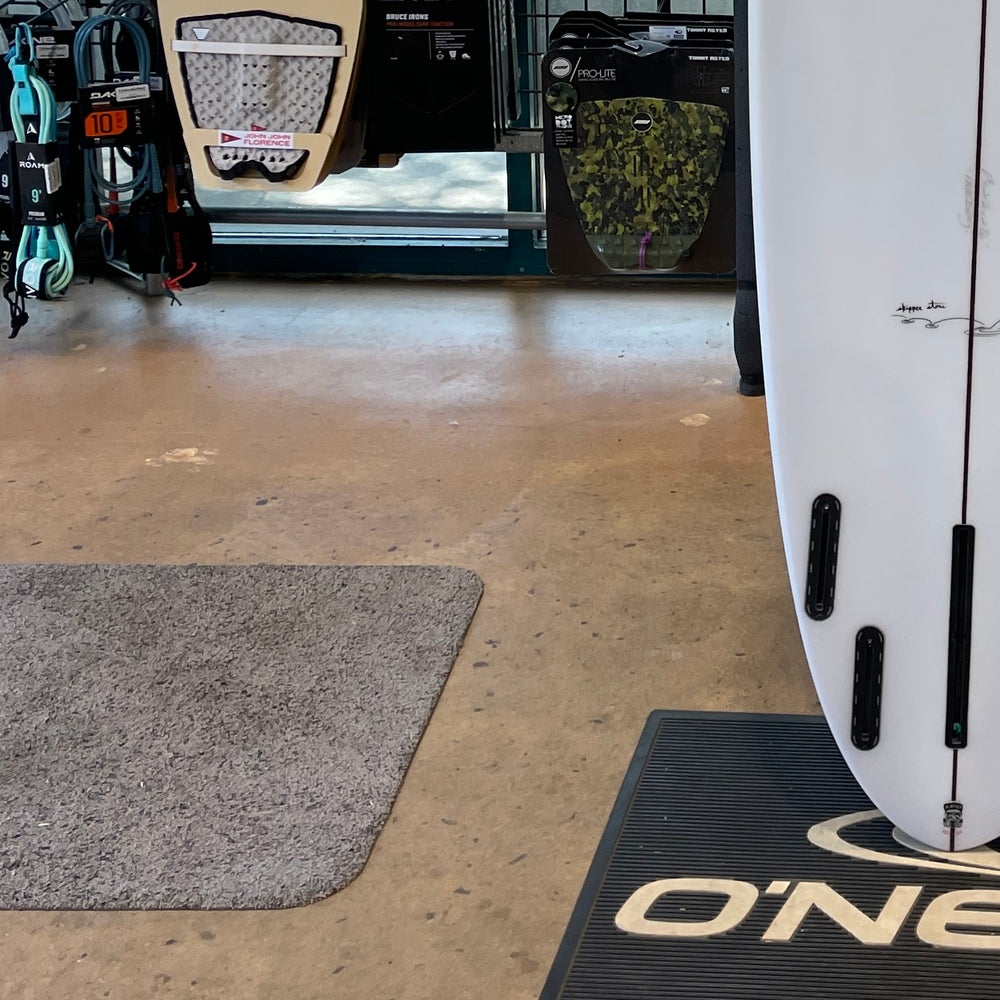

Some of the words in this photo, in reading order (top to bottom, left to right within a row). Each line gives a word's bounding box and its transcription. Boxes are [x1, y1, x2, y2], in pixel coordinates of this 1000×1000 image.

[386, 13, 407, 21] BRUCE
[408, 13, 429, 21] IRONS
[91, 112, 113, 135] 10
[19, 161, 46, 169] ROAM
